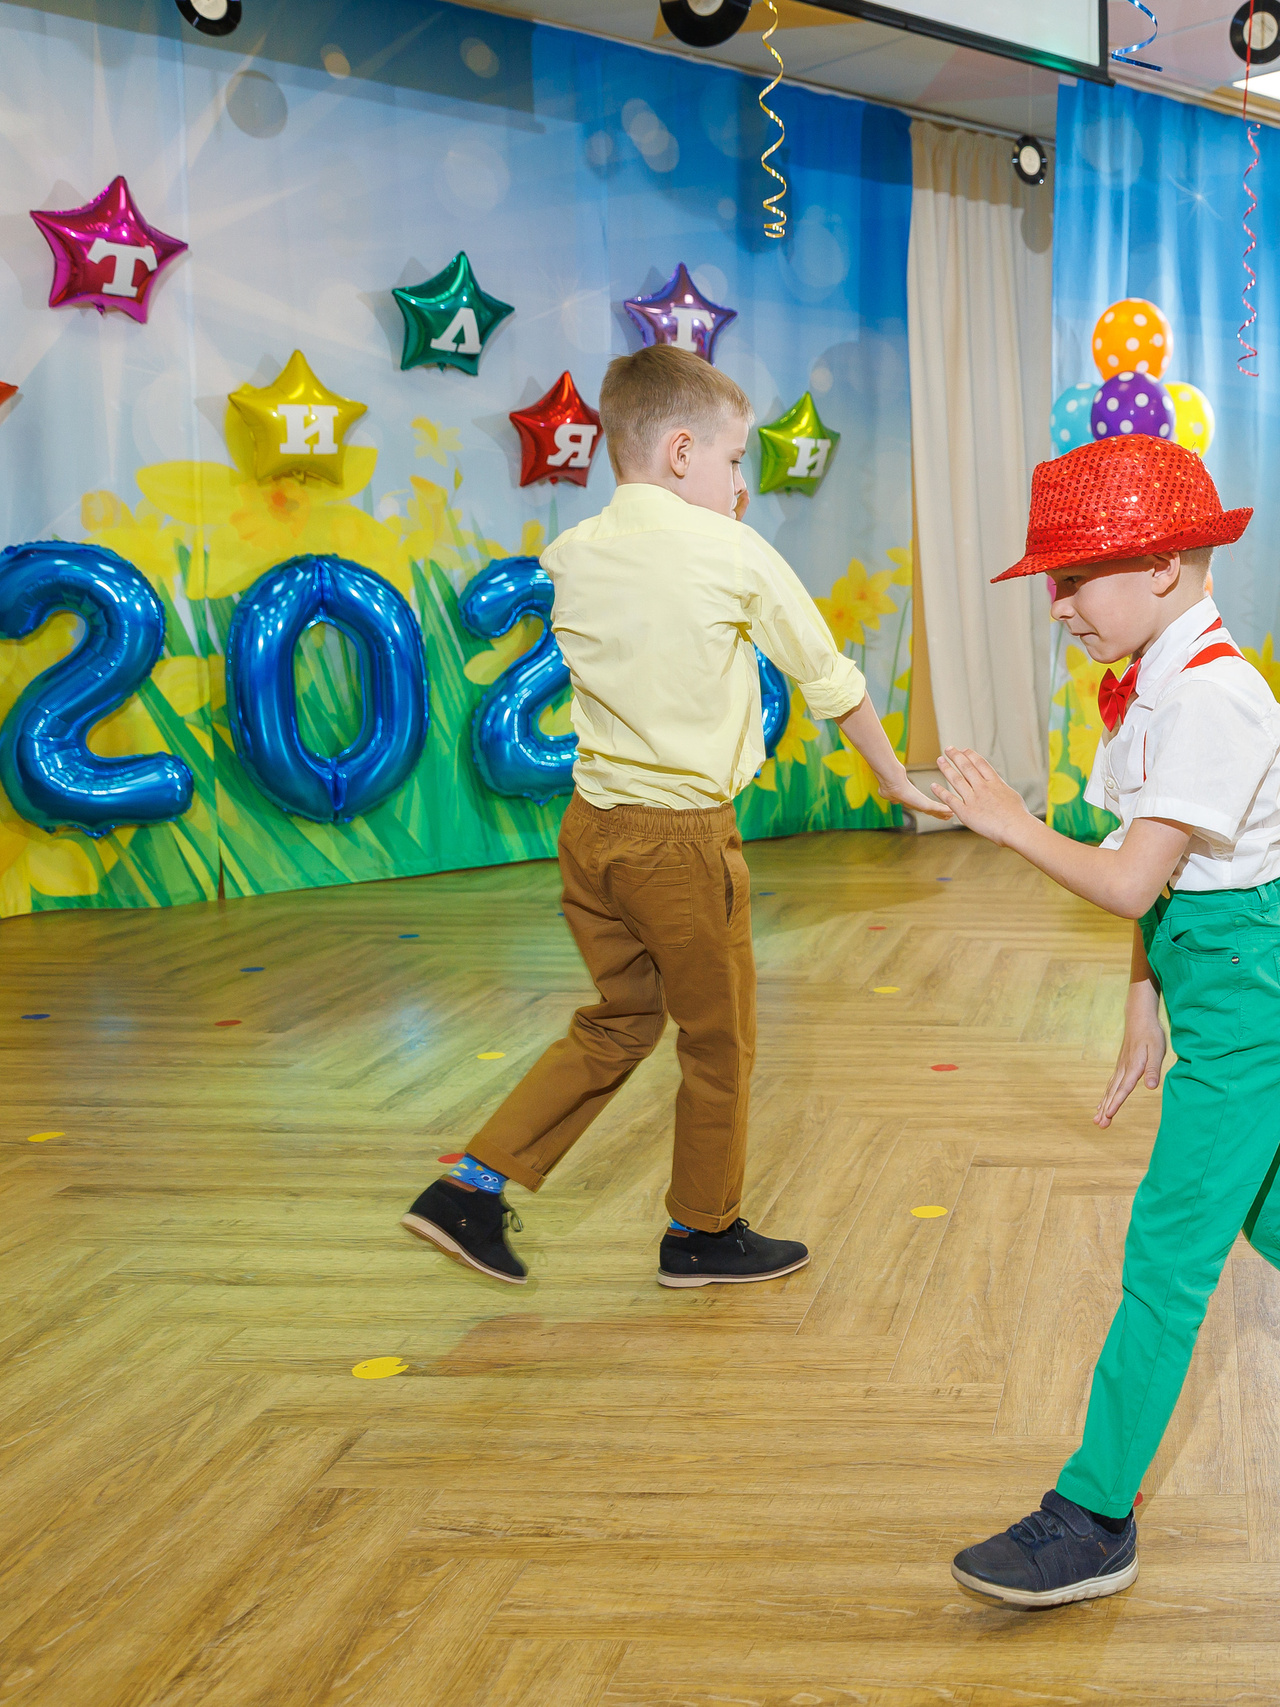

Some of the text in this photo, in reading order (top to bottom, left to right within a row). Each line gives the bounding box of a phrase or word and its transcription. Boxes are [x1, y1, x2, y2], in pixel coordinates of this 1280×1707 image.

[277, 404, 339, 454] И
[546, 423, 598, 468] Я
[787, 436, 831, 478] И
